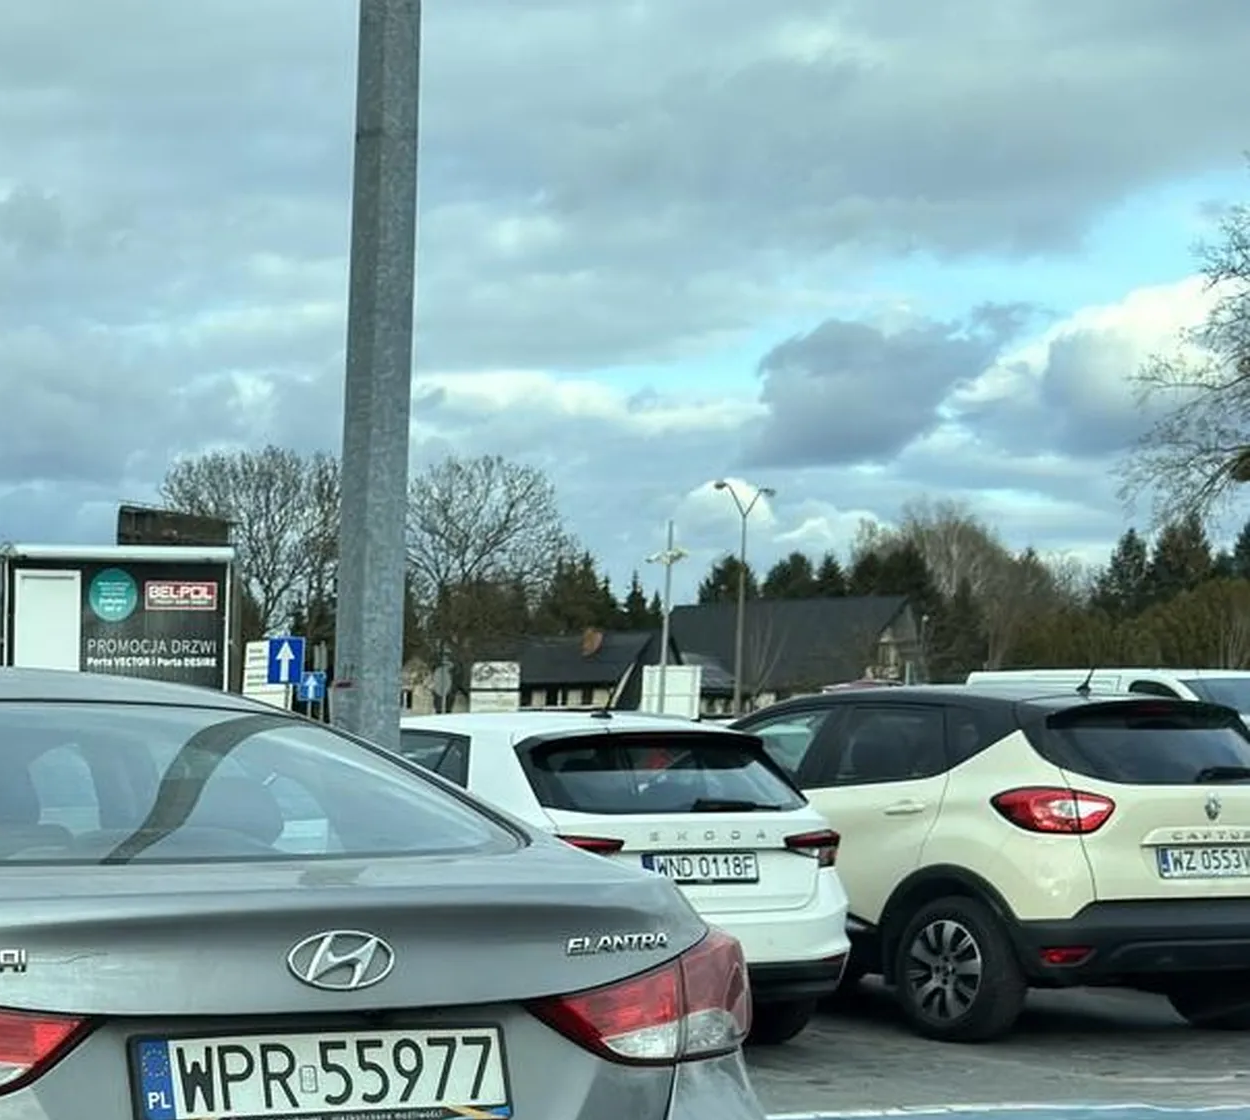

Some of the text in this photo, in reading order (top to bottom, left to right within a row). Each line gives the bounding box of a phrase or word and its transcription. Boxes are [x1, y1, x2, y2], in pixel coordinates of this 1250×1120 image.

[87, 638, 217, 654] PROMOCJA DRZWI
[656, 855, 754, 877] WND 0118F
[1171, 850, 1197, 871] WZ
[567, 932, 668, 956] ELANTRA
[176, 1036, 492, 1113] WPR 55977
[148, 1092, 171, 1109] PL
